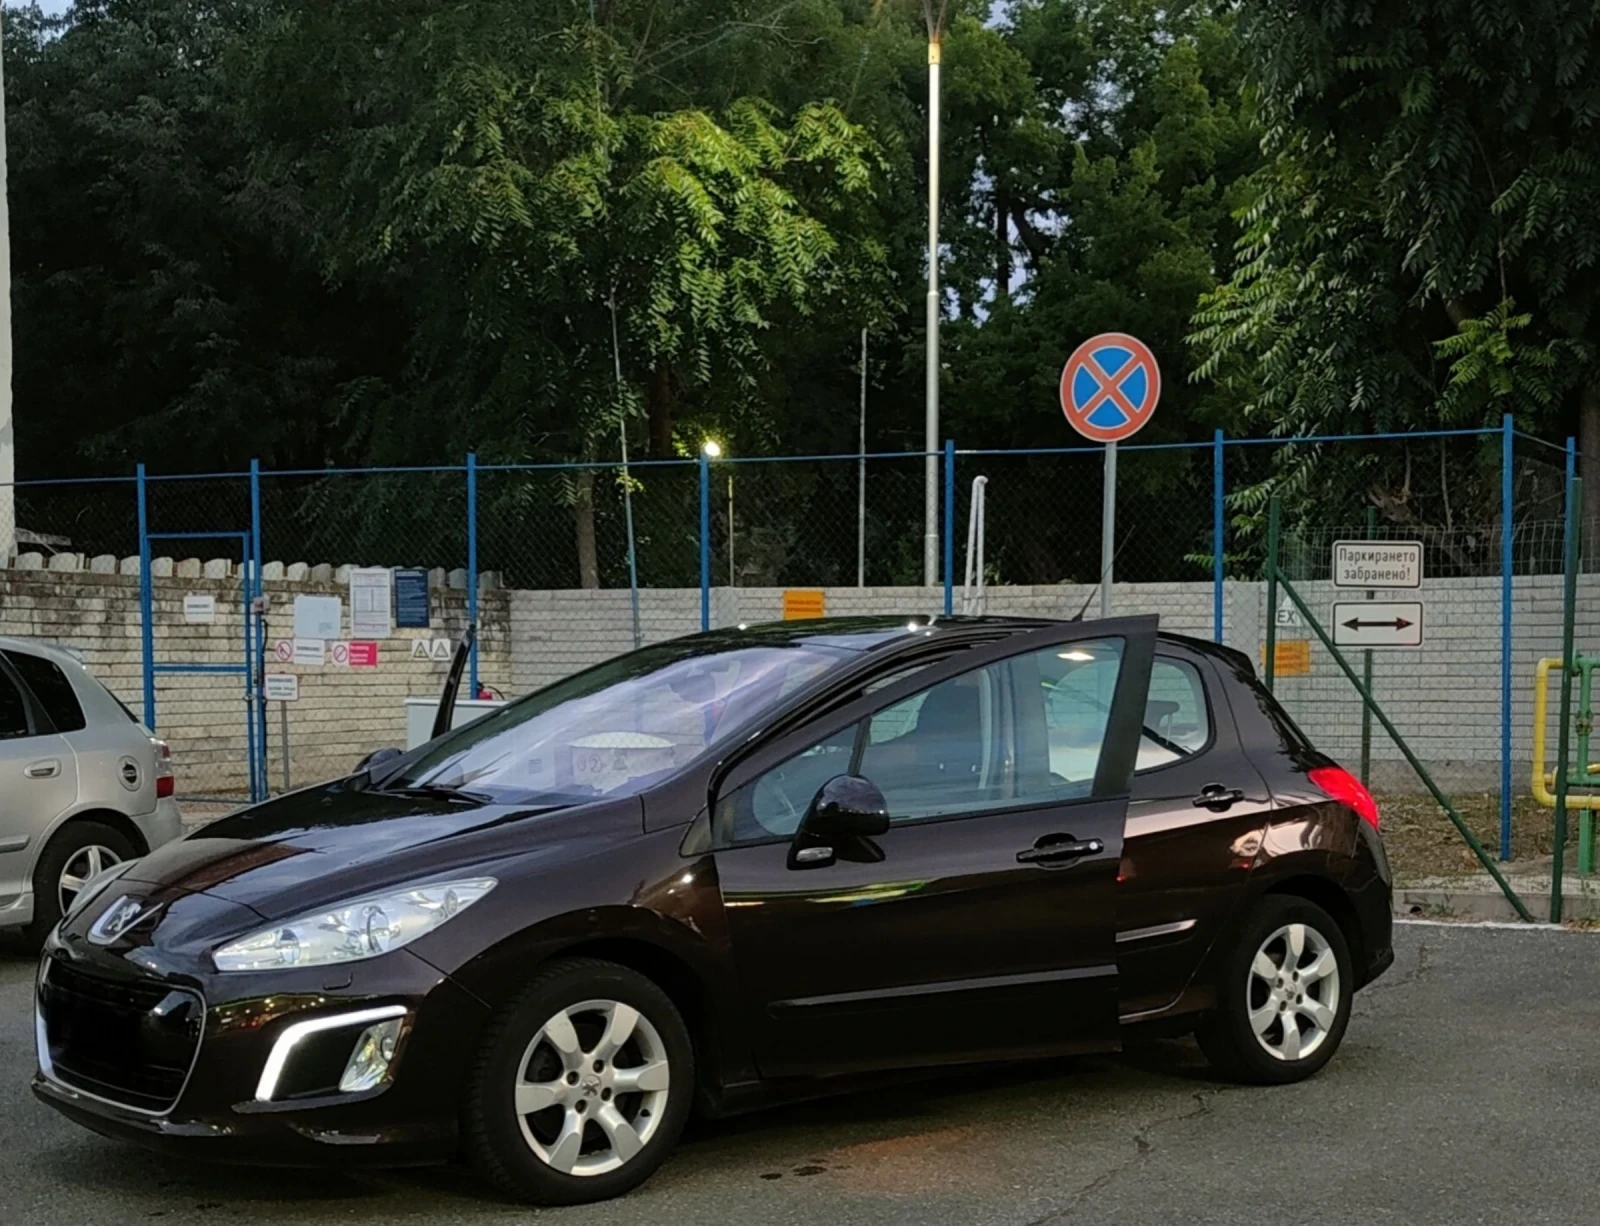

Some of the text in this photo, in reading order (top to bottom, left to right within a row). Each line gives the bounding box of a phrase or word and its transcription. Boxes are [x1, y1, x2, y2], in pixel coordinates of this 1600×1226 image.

[1340, 548, 1416, 564] Паркирането
[1344, 566, 1410, 582] забранено!
[1277, 609, 1295, 623] EX
